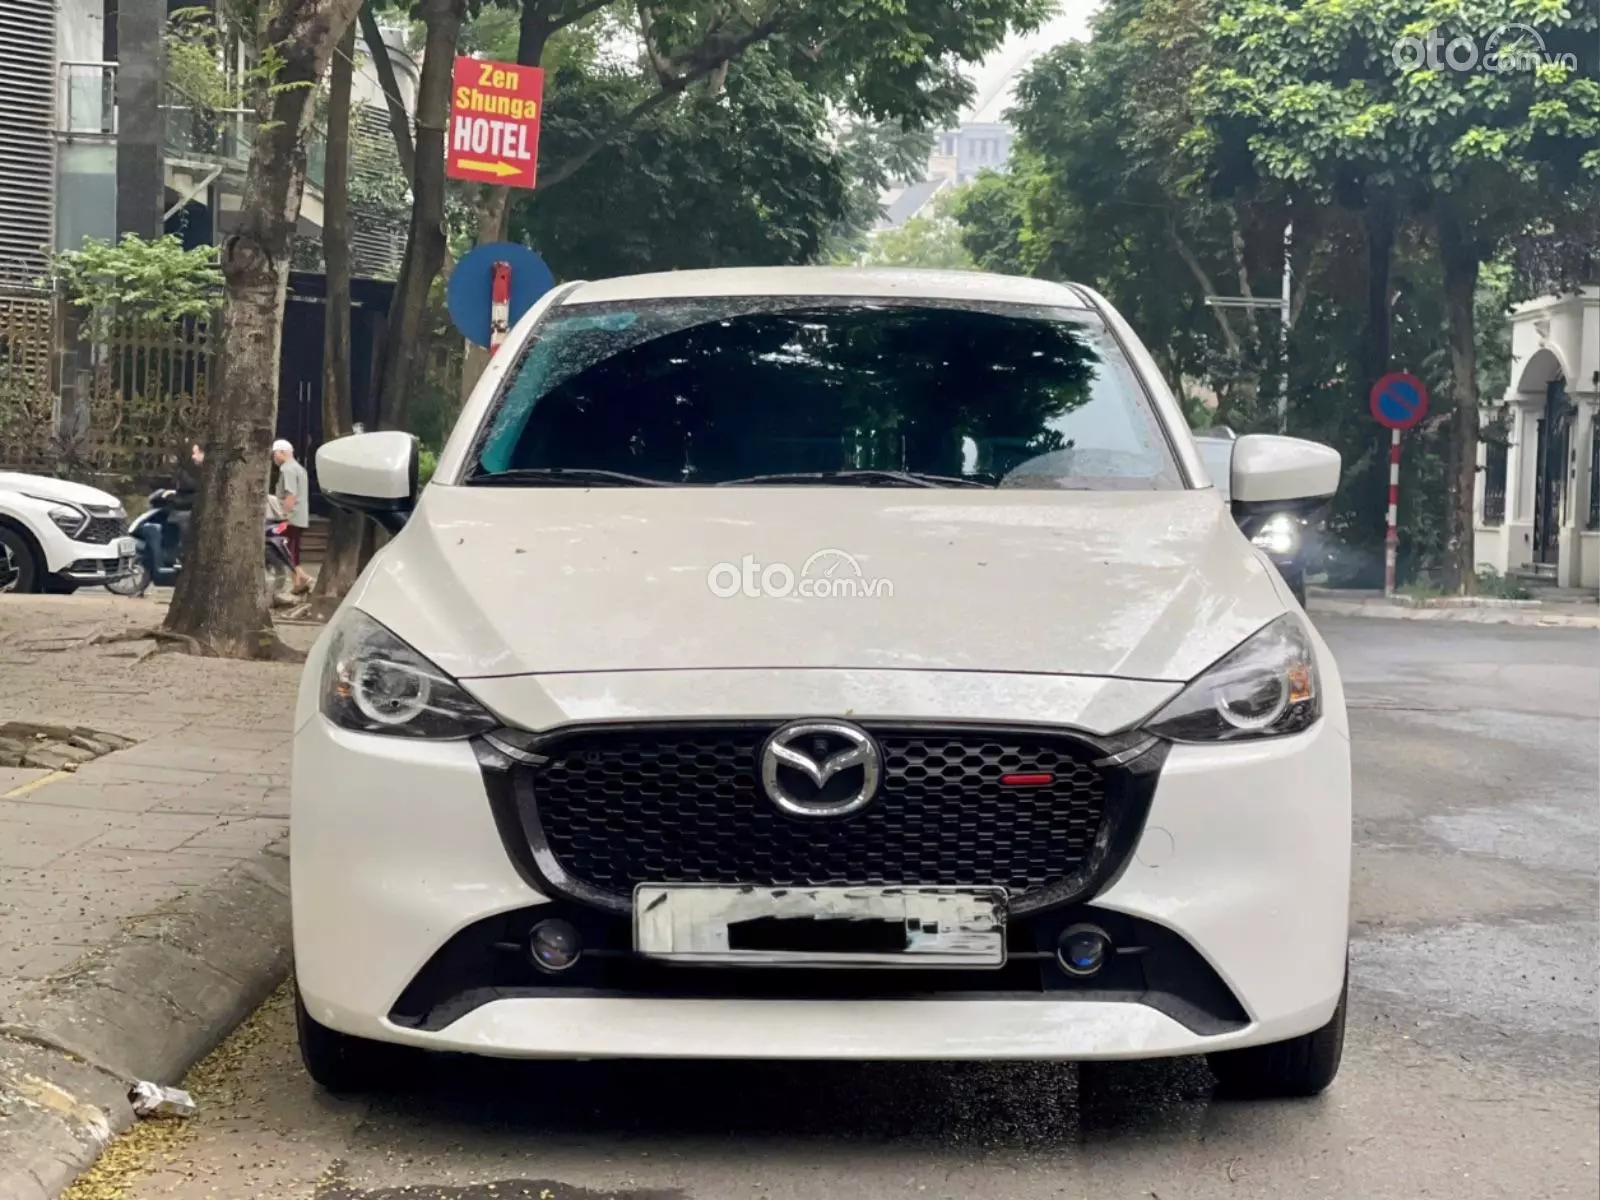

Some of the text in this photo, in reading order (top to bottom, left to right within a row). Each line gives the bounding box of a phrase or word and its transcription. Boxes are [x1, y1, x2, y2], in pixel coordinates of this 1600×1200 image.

[478, 63, 519, 91] Zen
[455, 86, 537, 119] Shunga
[453, 115, 531, 160] HOTEL
